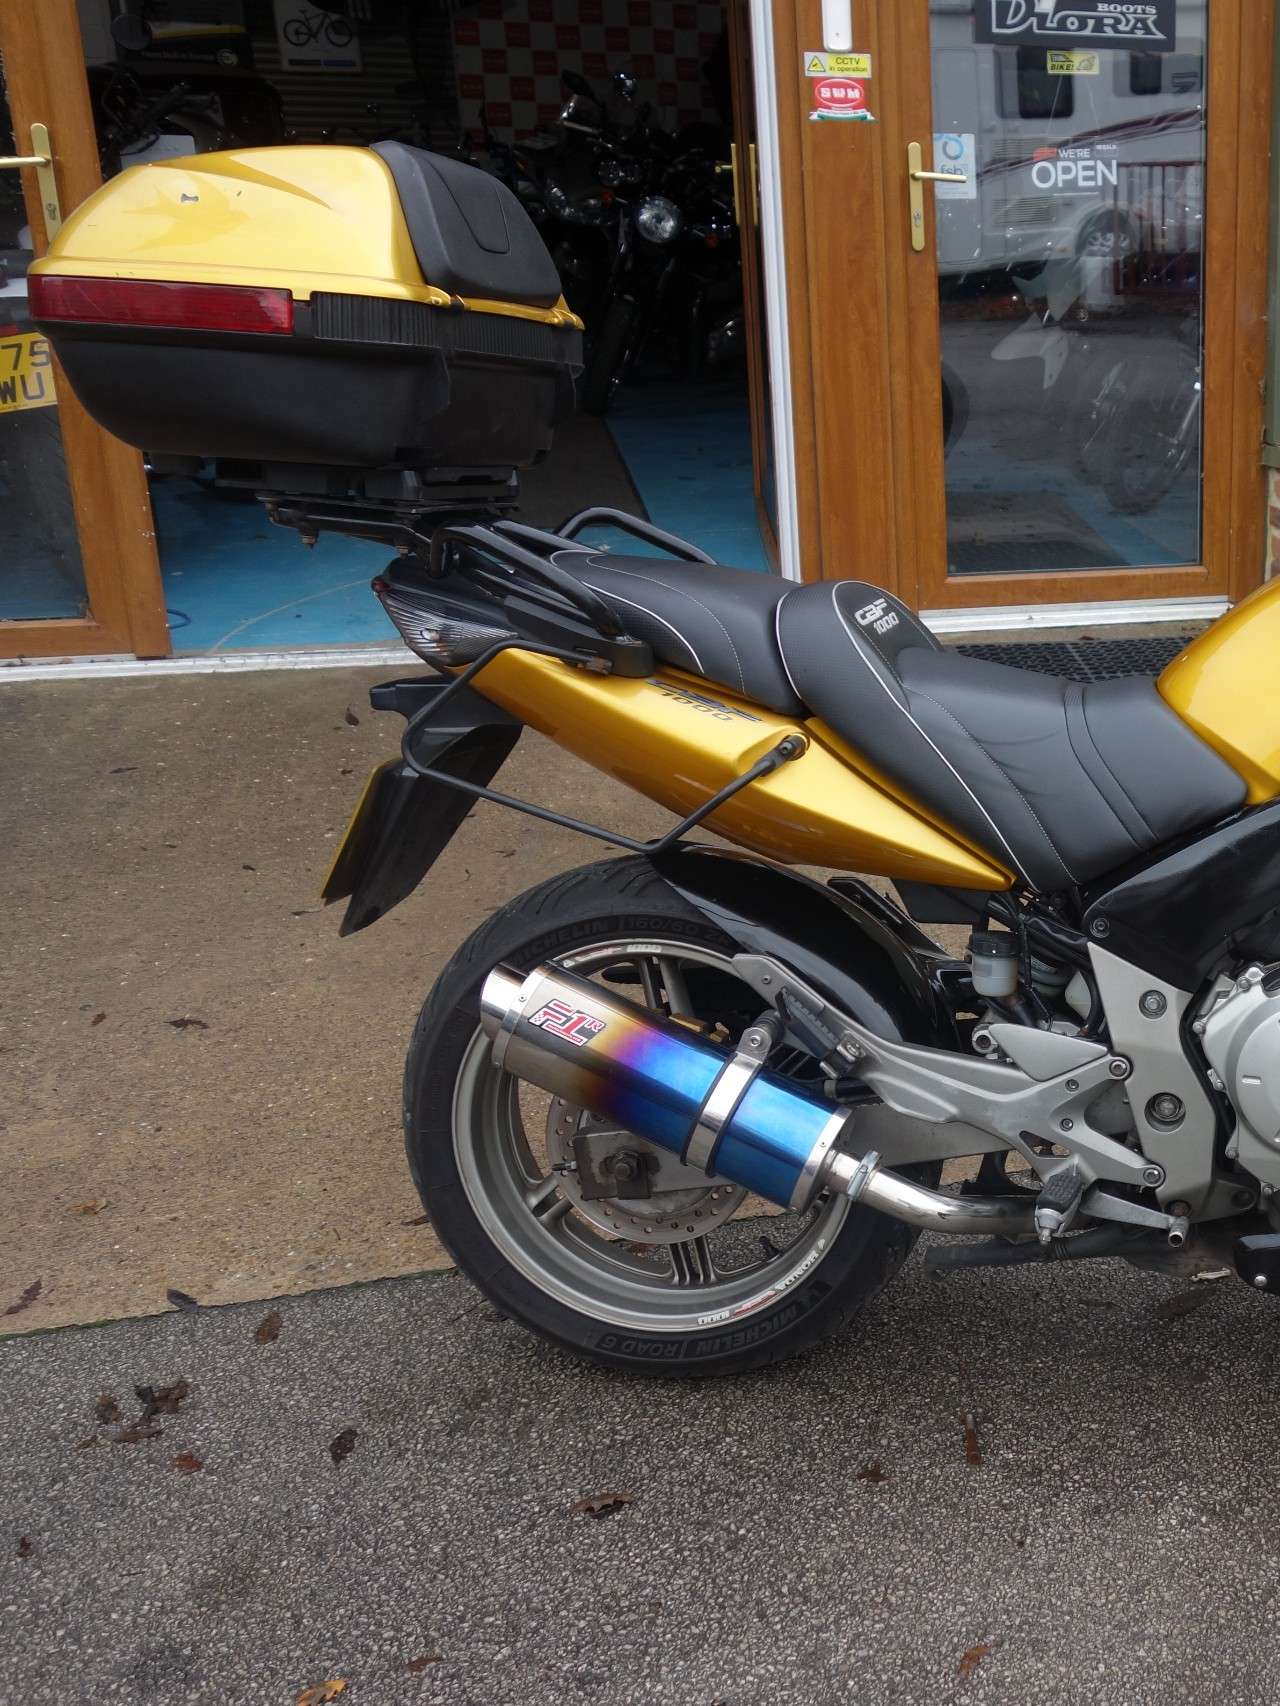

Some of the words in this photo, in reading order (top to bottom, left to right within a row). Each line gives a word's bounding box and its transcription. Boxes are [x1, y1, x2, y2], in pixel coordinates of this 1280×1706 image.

[1097, 2, 1156, 14] BOOTS
[835, 56, 860, 65] CCTV
[1031, 160, 1118, 188] OPEN
[854, 598, 887, 625] CBF
[873, 611, 900, 634] 1000
